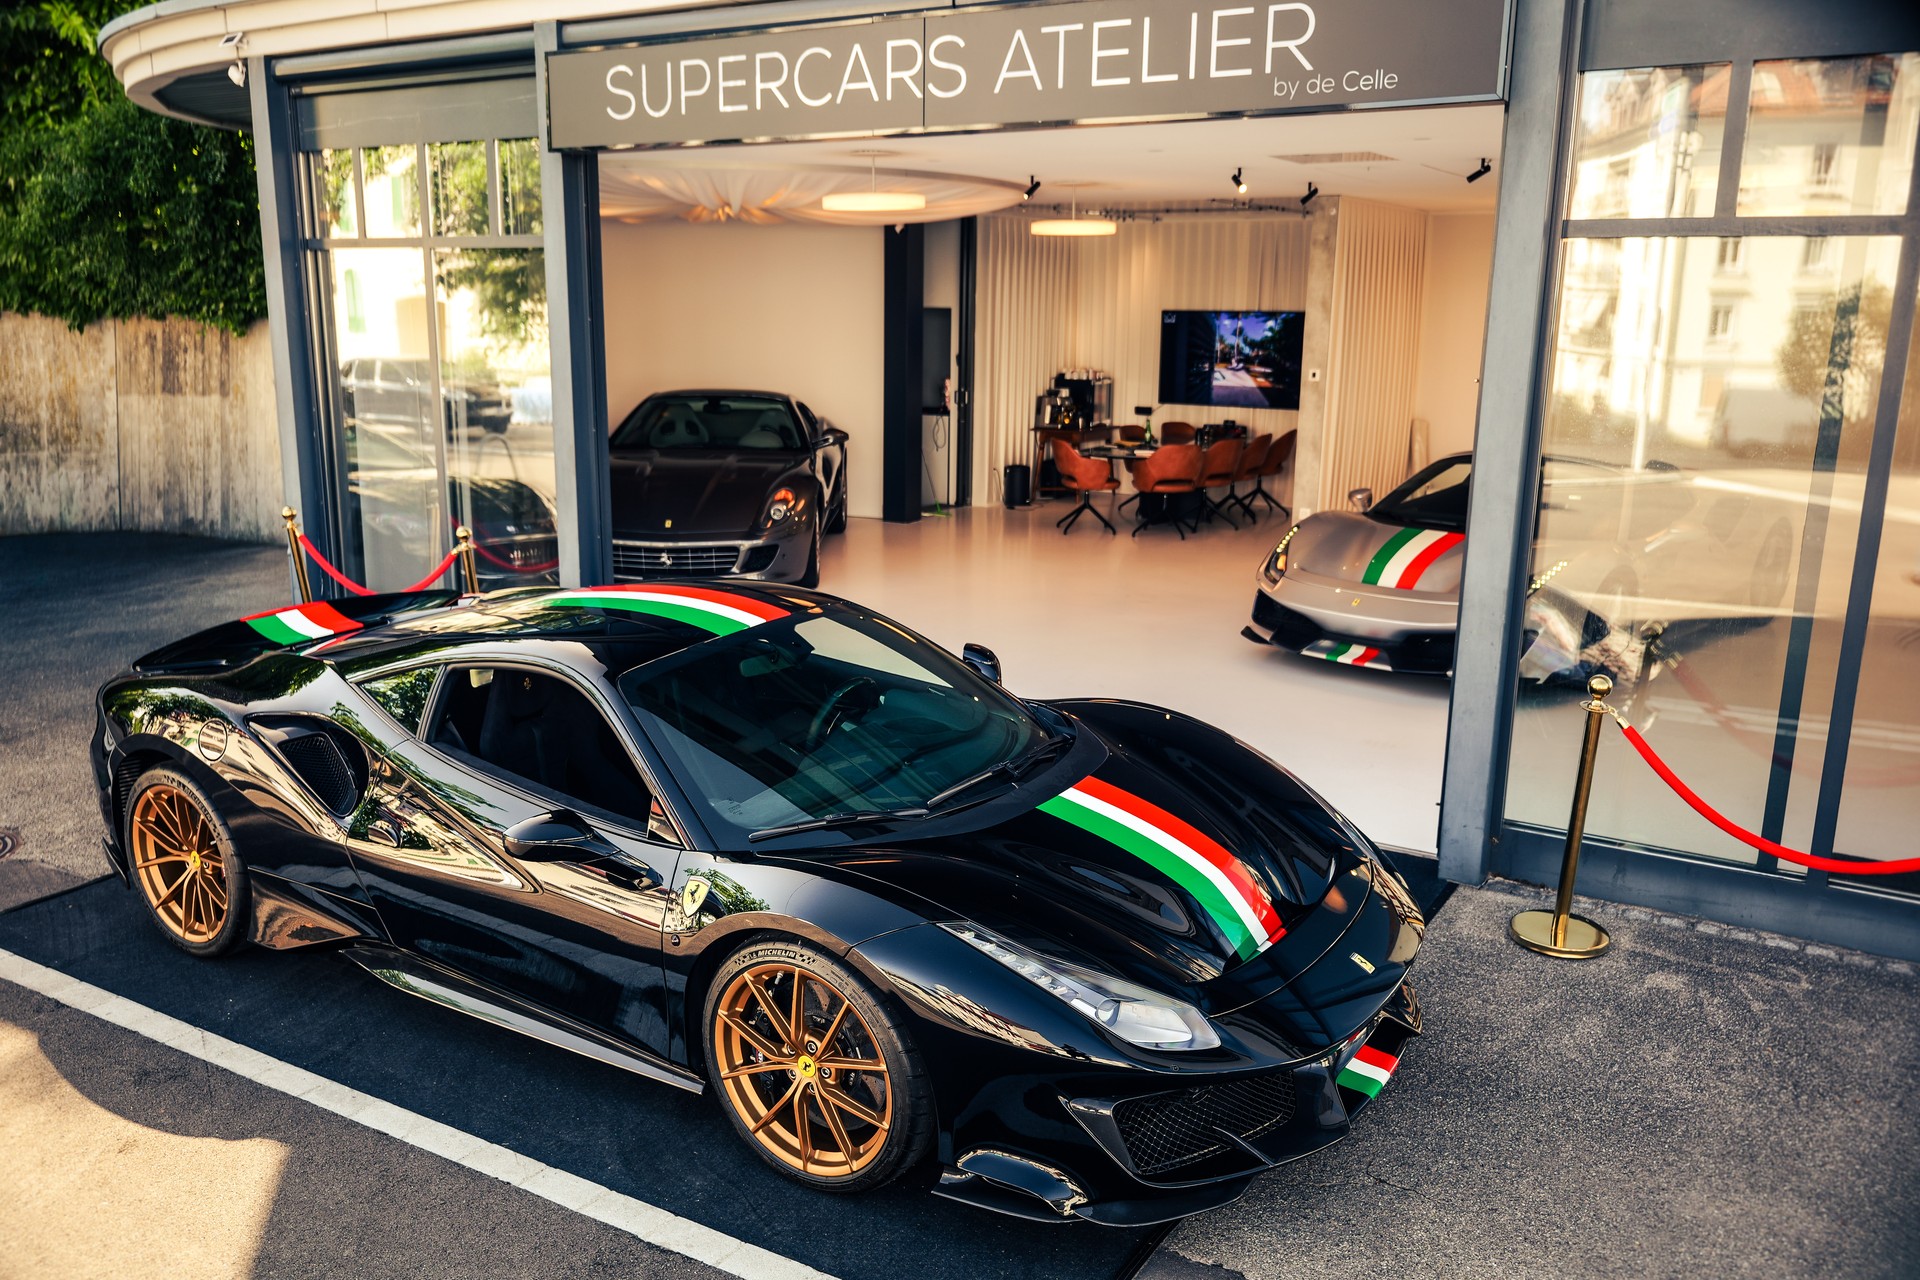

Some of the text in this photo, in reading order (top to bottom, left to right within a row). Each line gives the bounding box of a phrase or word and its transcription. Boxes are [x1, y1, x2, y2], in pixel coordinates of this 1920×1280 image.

[606, 2, 1316, 120] SUPERCARS ATELIER
[1273, 69, 1399, 100] by de Celle
[757, 948, 797, 960] MICHELIN
